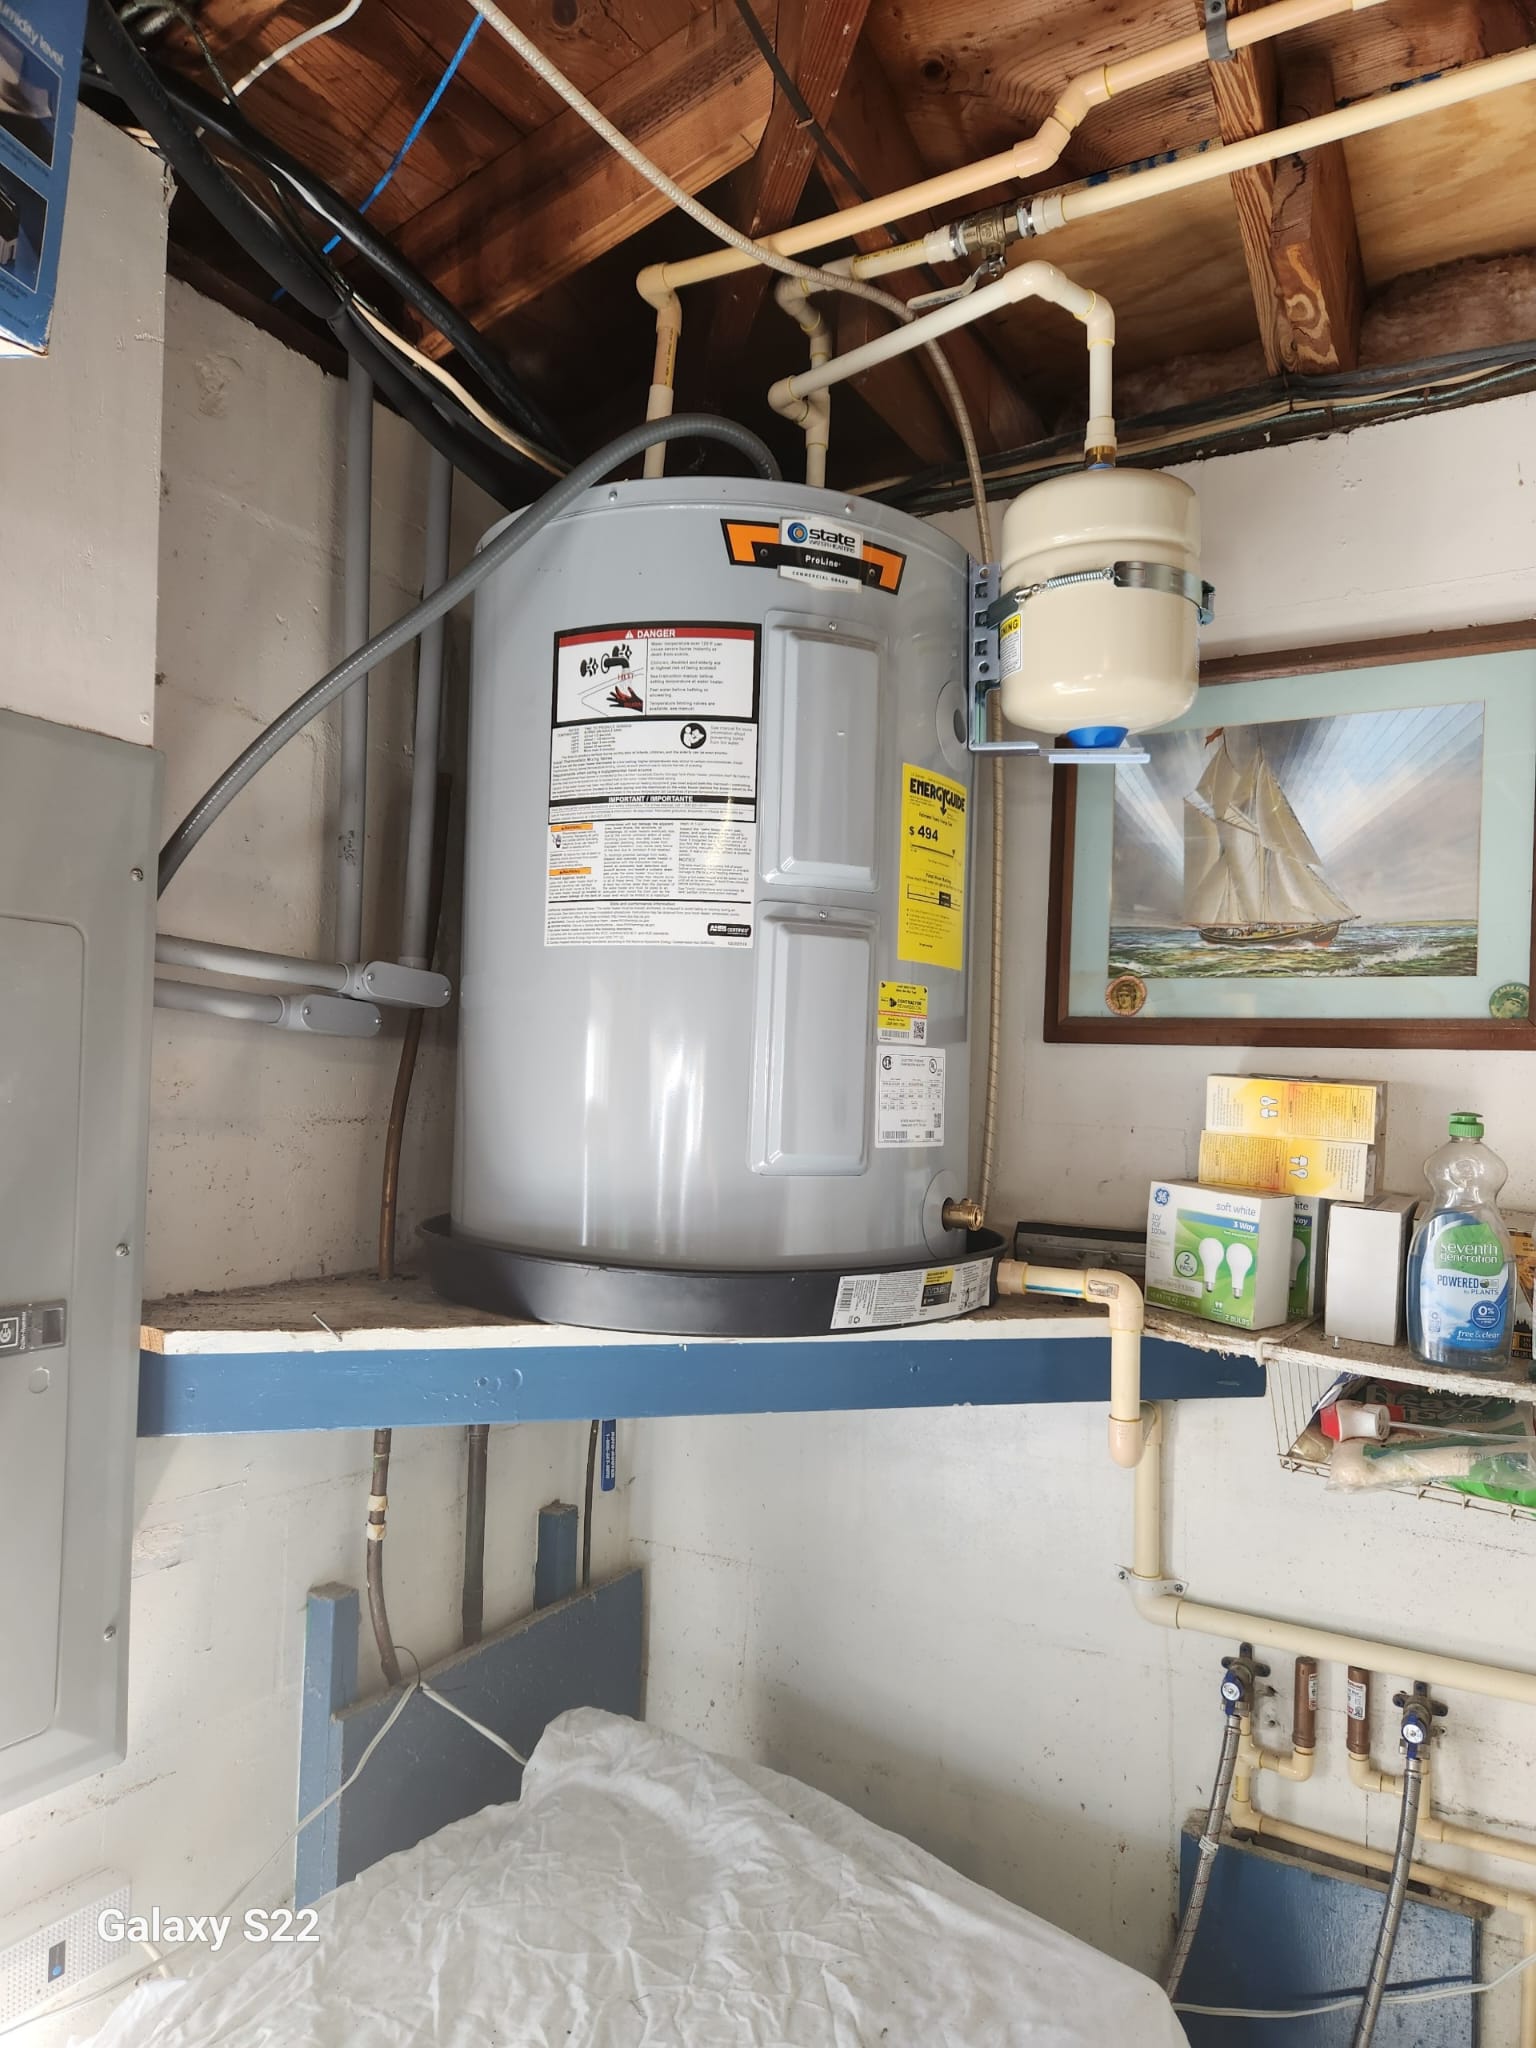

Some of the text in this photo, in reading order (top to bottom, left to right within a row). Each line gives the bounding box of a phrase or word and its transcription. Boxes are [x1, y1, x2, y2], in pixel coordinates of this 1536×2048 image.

[809, 528, 856, 548] state
[637, 629, 676, 639] DANGER
[650, 795, 694, 803] IMPORTANTE
[917, 825, 939, 842] 494
[1215, 1201, 1256, 1217] soft white
[1240, 1222, 1256, 1233] Way
[1183, 1254, 1190, 1265] 2
[1440, 1252, 1498, 1265] generation
[1437, 1275, 1479, 1289] POWERED
[1457, 1329, 1474, 1338] free
